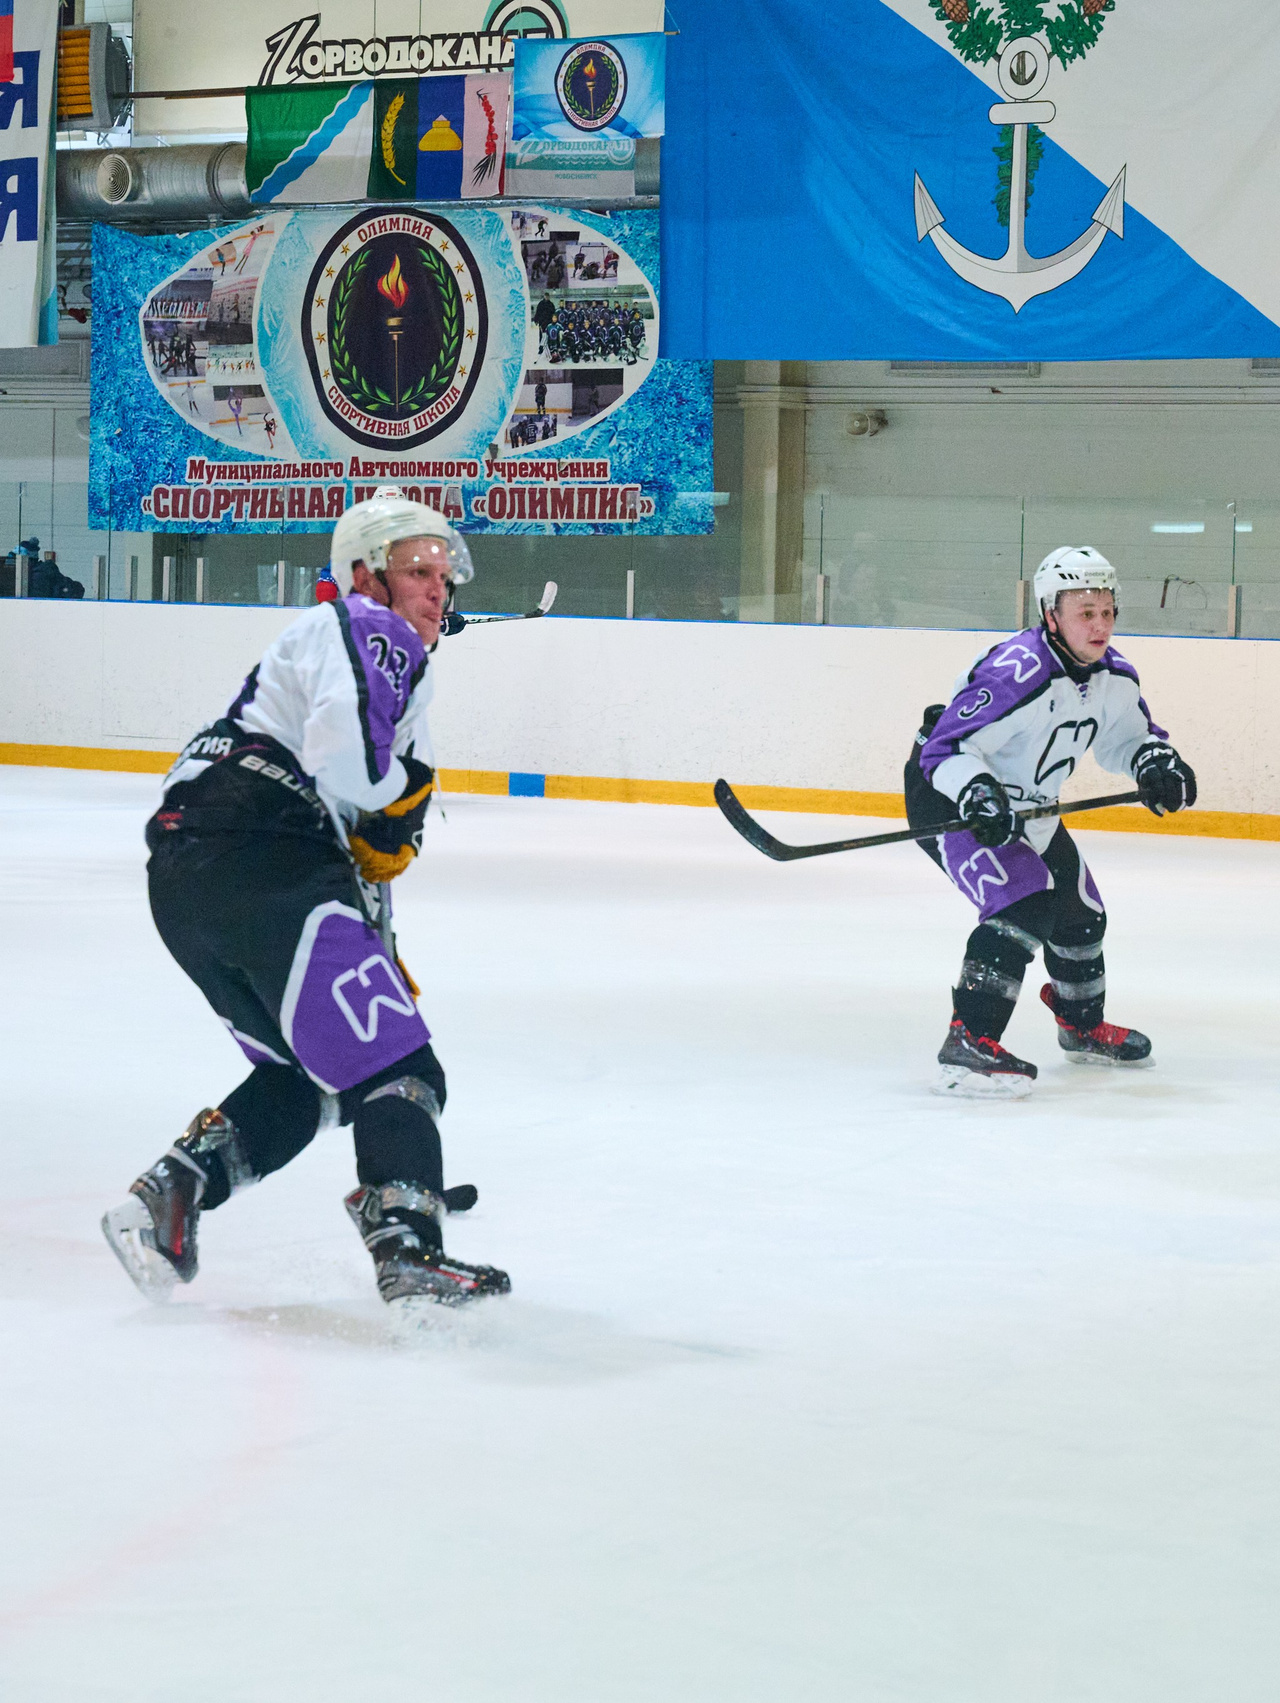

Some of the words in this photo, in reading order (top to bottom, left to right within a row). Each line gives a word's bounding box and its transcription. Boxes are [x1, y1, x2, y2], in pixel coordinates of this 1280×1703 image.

[356, 216, 434, 244] ОЛИМПИЯ
[327, 385, 411, 437] СПОРТИВНАЯ
[413, 385, 461, 430] ШКОЛА
[187, 460, 344, 484] Муниципального
[349, 456, 478, 478] Автономного
[485, 459, 609, 482] Учреждения
[473, 486, 653, 520] «ОЛИМПИЯ»
[957, 688, 993, 720] 3
